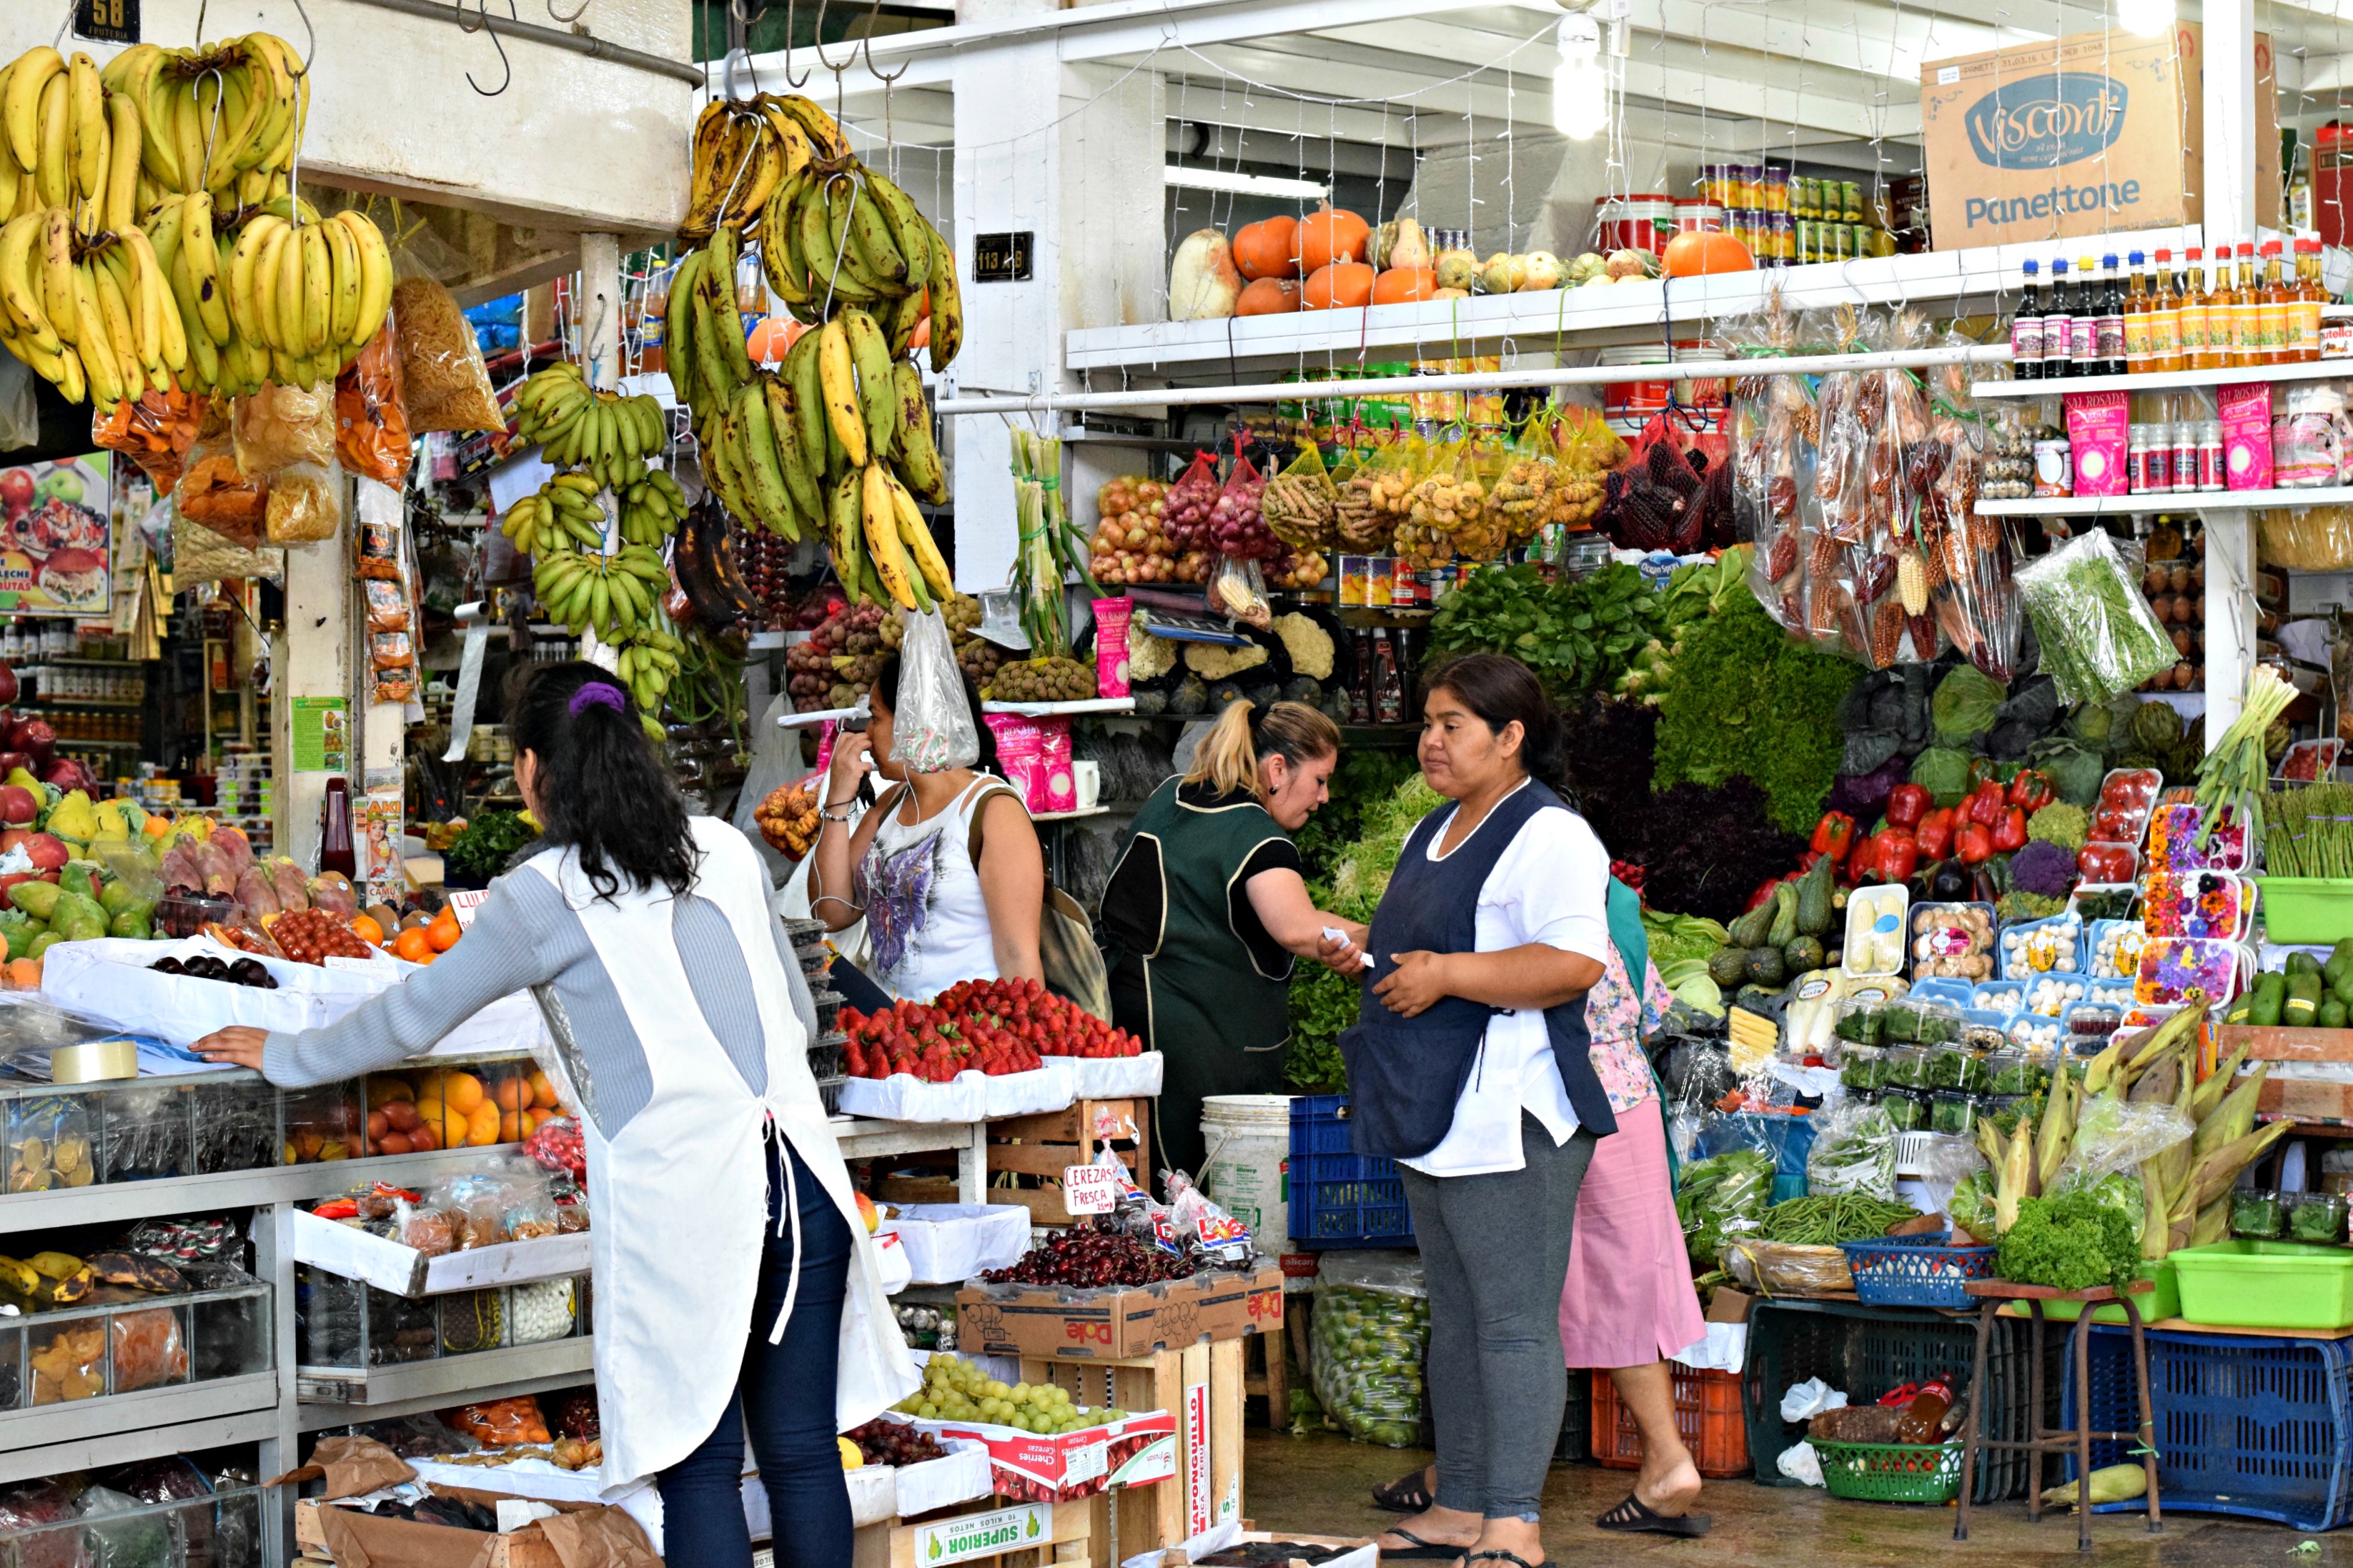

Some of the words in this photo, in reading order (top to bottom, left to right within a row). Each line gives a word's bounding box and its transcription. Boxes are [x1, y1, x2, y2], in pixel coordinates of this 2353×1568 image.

[93, 0, 124, 28] 58
[89, 26, 129, 40] FRUTERIA
[2002, 54, 2038, 68] 31.03.16
[2083, 43, 2104, 54] 1048
[1974, 87, 2119, 153] Visconti
[1966, 179, 2140, 228] Panettone
[979, 252, 999, 270] 113
[2066, 397, 2084, 410] SAL
[2086, 392, 2126, 408] ROSADA
[2235, 404, 2259, 413] NATURAL
[2088, 412, 2116, 421] NATURAL
[1641, 562, 1662, 575] Ocean
[1661, 562, 1680, 575] Spray
[1004, 724, 1040, 738] ROSADA
[367, 800, 401, 814] AKI
[370, 888, 396, 896] CAMU
[1066, 1167, 1113, 1187] CEREZAS
[1073, 1189, 1107, 1206] FRESCA
[1247, 1290, 1282, 1322] Dole
[1066, 1321, 1112, 1344] Dole
[1068, 1435, 1087, 1444] Cerezas
[1028, 1444, 1055, 1454] Cerezas
[1019, 1453, 1054, 1465] Cherries
[950, 1522, 974, 1533] NETOS
[980, 1516, 1002, 1527] KILOS
[948, 1525, 1018, 1554] SUPERIOR
